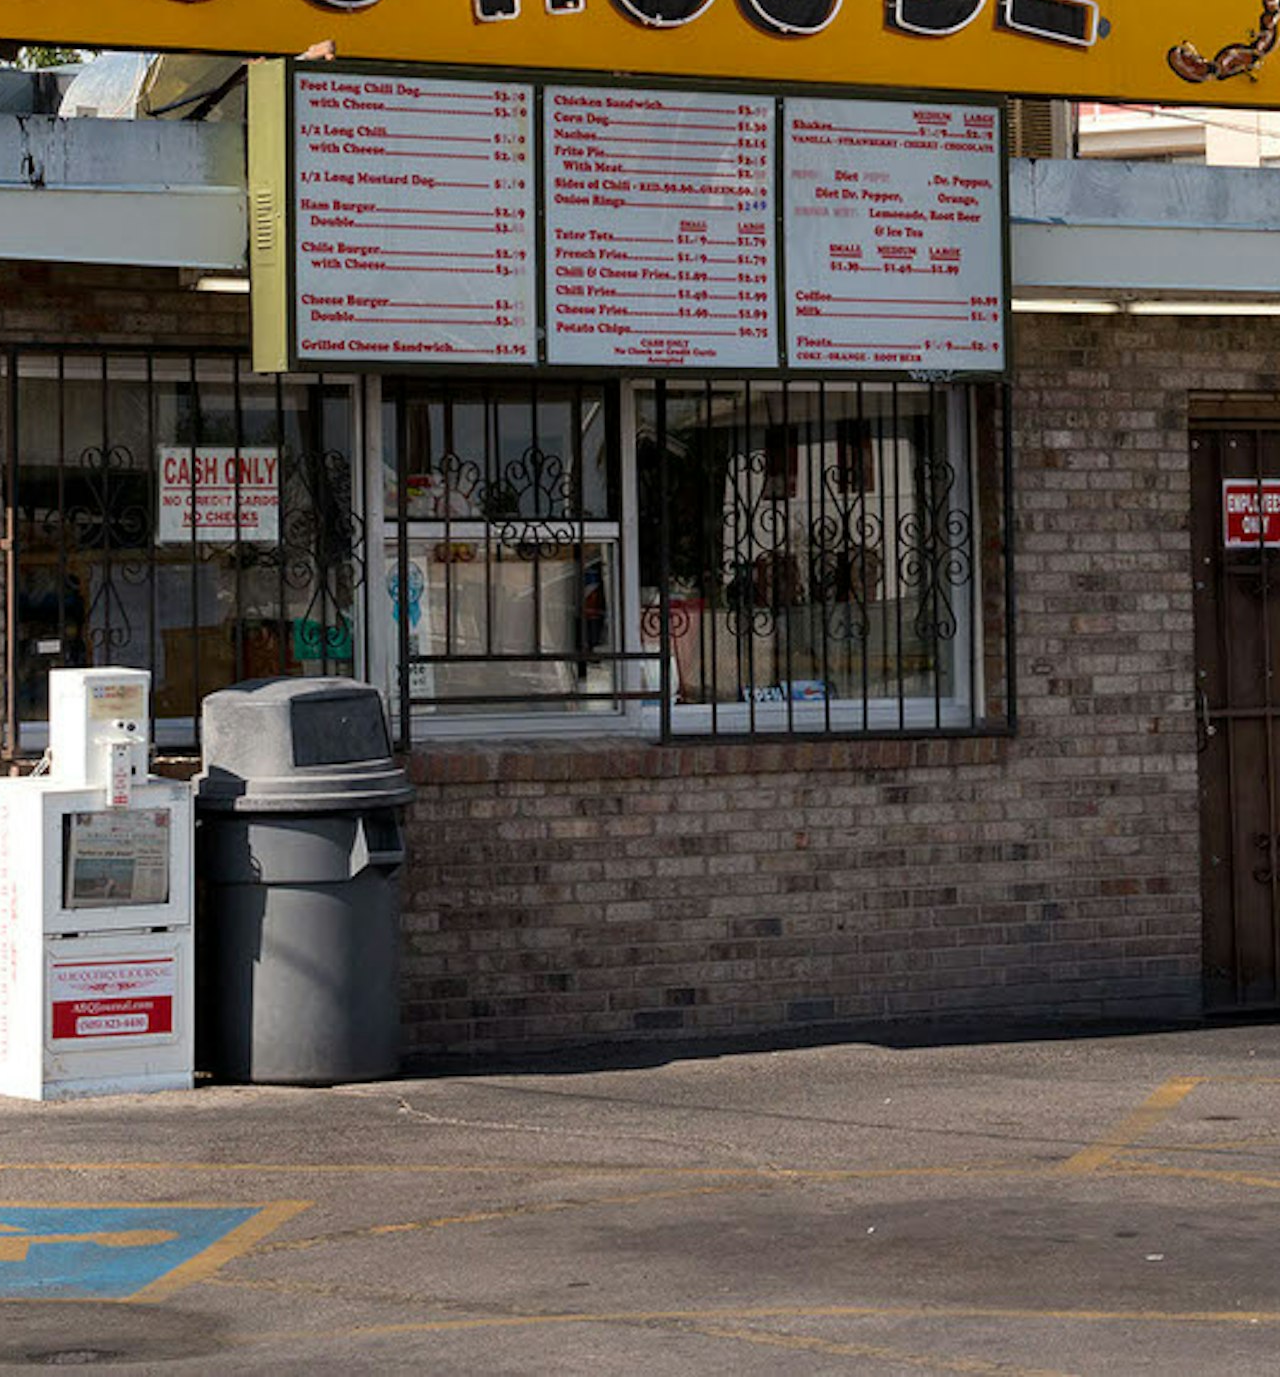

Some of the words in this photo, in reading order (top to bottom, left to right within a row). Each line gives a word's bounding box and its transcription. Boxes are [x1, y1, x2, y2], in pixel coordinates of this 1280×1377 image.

[300, 79, 328, 91] Foot
[330, 80, 361, 95] Long
[397, 84, 420, 98] Dog
[309, 98, 339, 108] with
[342, 98, 385, 110] Cheese
[553, 95, 602, 107] Chicken
[606, 97, 663, 110] Sandwich
[553, 111, 583, 123] Corn
[587, 112, 609, 126] Dog
[963, 112, 995, 123] LARGE
[301, 124, 320, 137] 1/2
[324, 124, 354, 138] Long
[553, 128, 597, 139] Nachos
[309, 143, 339, 153] with
[342, 143, 385, 154] Cheese
[563, 160, 592, 172] With
[595, 161, 623, 173] Meat
[301, 171, 320, 184] 1/2
[324, 171, 354, 186] Long
[357, 172, 408, 184] Mustard
[412, 174, 434, 188] Dog
[835, 170, 859, 181] Diet
[587, 179, 599, 189] of
[554, 193, 590, 204] Onion
[815, 186, 839, 199] Diet
[861, 188, 904, 203] Pepper,
[938, 193, 979, 206] Orange,
[301, 199, 329, 210] Ham
[333, 200, 376, 214] Burger
[311, 215, 355, 226] Double
[869, 207, 928, 221] Lemonade,
[930, 210, 955, 221] Root
[957, 211, 981, 222] Beer
[875, 225, 885, 236] &
[886, 225, 902, 237] Ice
[905, 227, 923, 237] Tea
[337, 242, 381, 256] Burger
[555, 247, 596, 259] French
[600, 248, 628, 260] Fries
[928, 246, 961, 256] LARGE
[311, 258, 341, 269] with
[345, 258, 386, 270] Cheese
[587, 266, 596, 277] &
[600, 267, 638, 278] Cheese
[642, 268, 670, 279] Fries
[587, 285, 616, 297] Fries
[795, 289, 832, 301] Coffee
[301, 294, 344, 305] Cheese
[347, 294, 390, 309] Burger
[311, 310, 355, 322] Double
[556, 304, 596, 315] Cheese
[600, 304, 628, 315] Fries
[795, 305, 821, 316] Milk
[556, 321, 594, 333] Potato
[597, 322, 630, 336] Chips
[301, 339, 345, 351] Grilled
[348, 340, 390, 352] Cheese
[393, 340, 453, 353] Sandwich
[796, 335, 832, 348] Floats
[164, 457, 217, 484] CASH
[225, 457, 277, 484] ONLY
